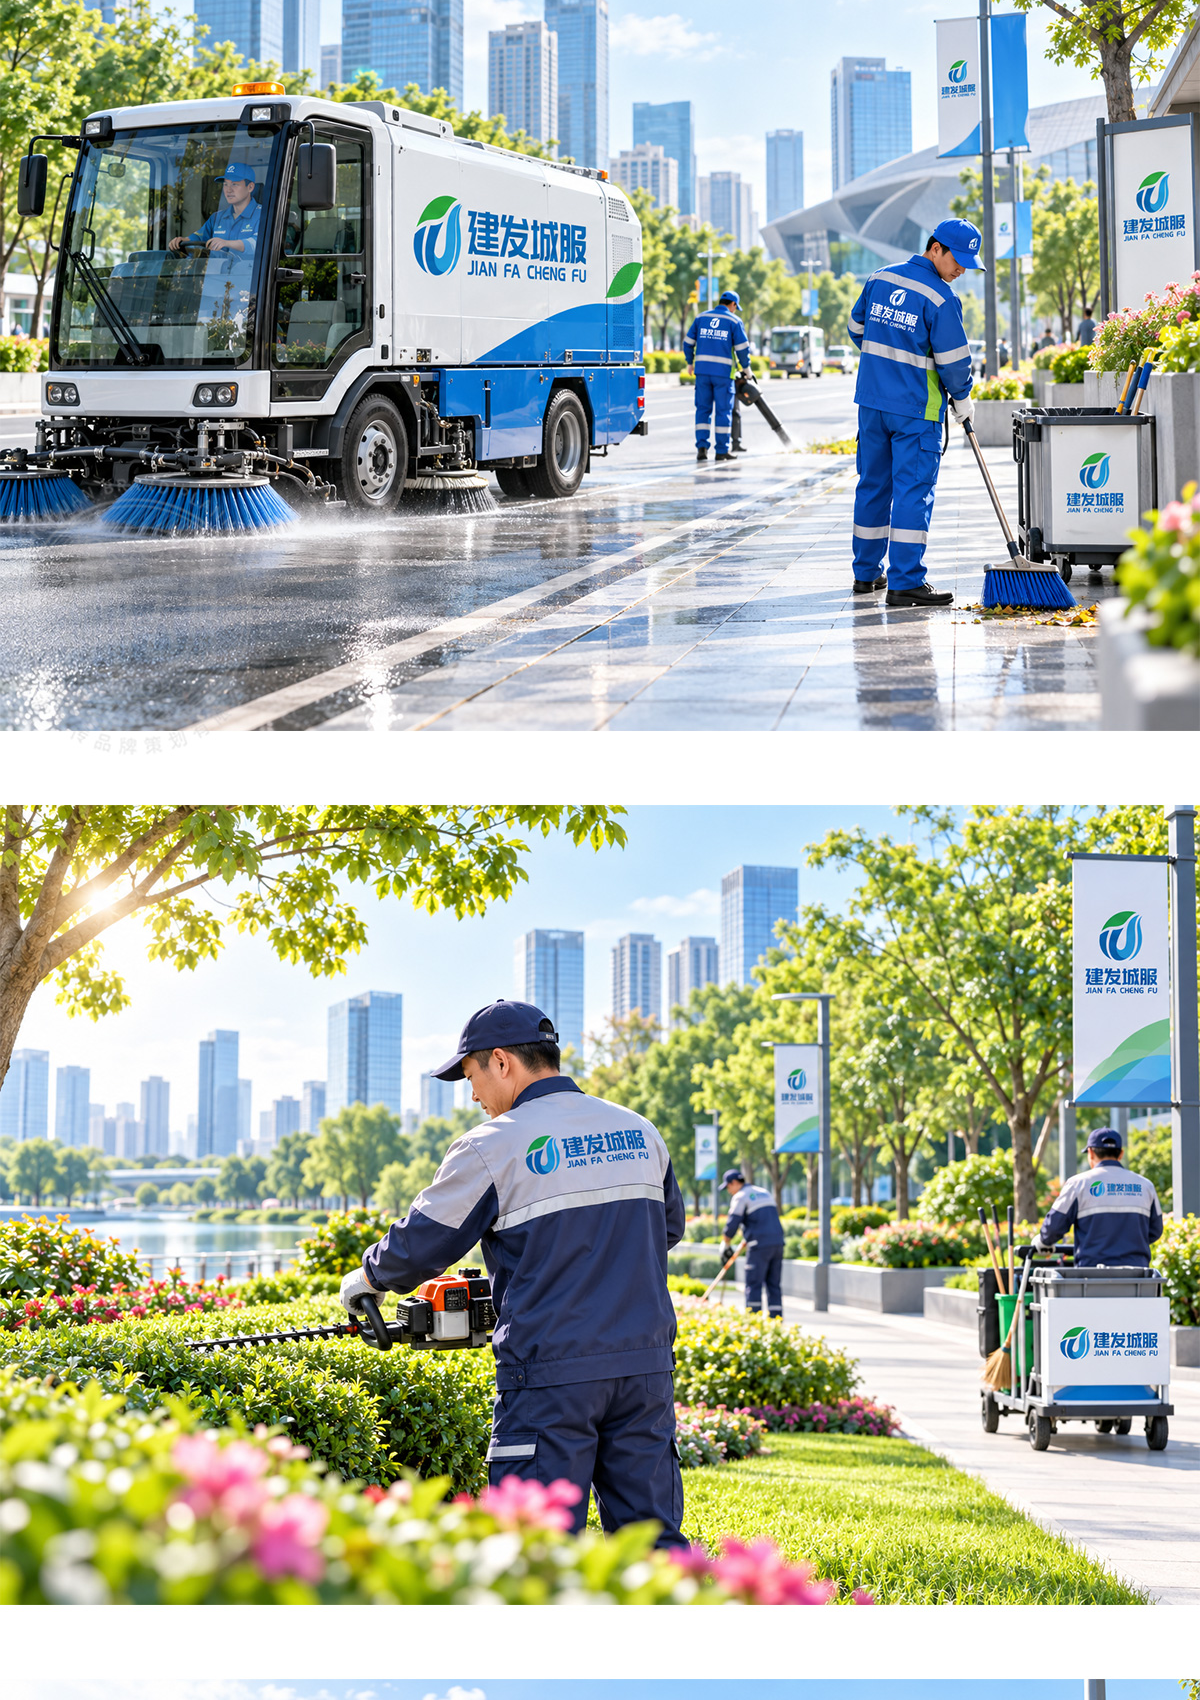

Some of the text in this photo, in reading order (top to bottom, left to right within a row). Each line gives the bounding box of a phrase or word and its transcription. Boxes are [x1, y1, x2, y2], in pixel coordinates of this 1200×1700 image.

[1123, 214, 1185, 235] 建发城服
[467, 210, 587, 265] 建发城服
[467, 260, 586, 283] JIAN FA CHENG FU
[870, 302, 918, 327] 建发城服
[1067, 493, 1124, 506] 建发城服
[1086, 968, 1157, 985] 建发城服
[562, 1129, 647, 1158] 建发城服
[1094, 1333, 1158, 1348] 建发城服
